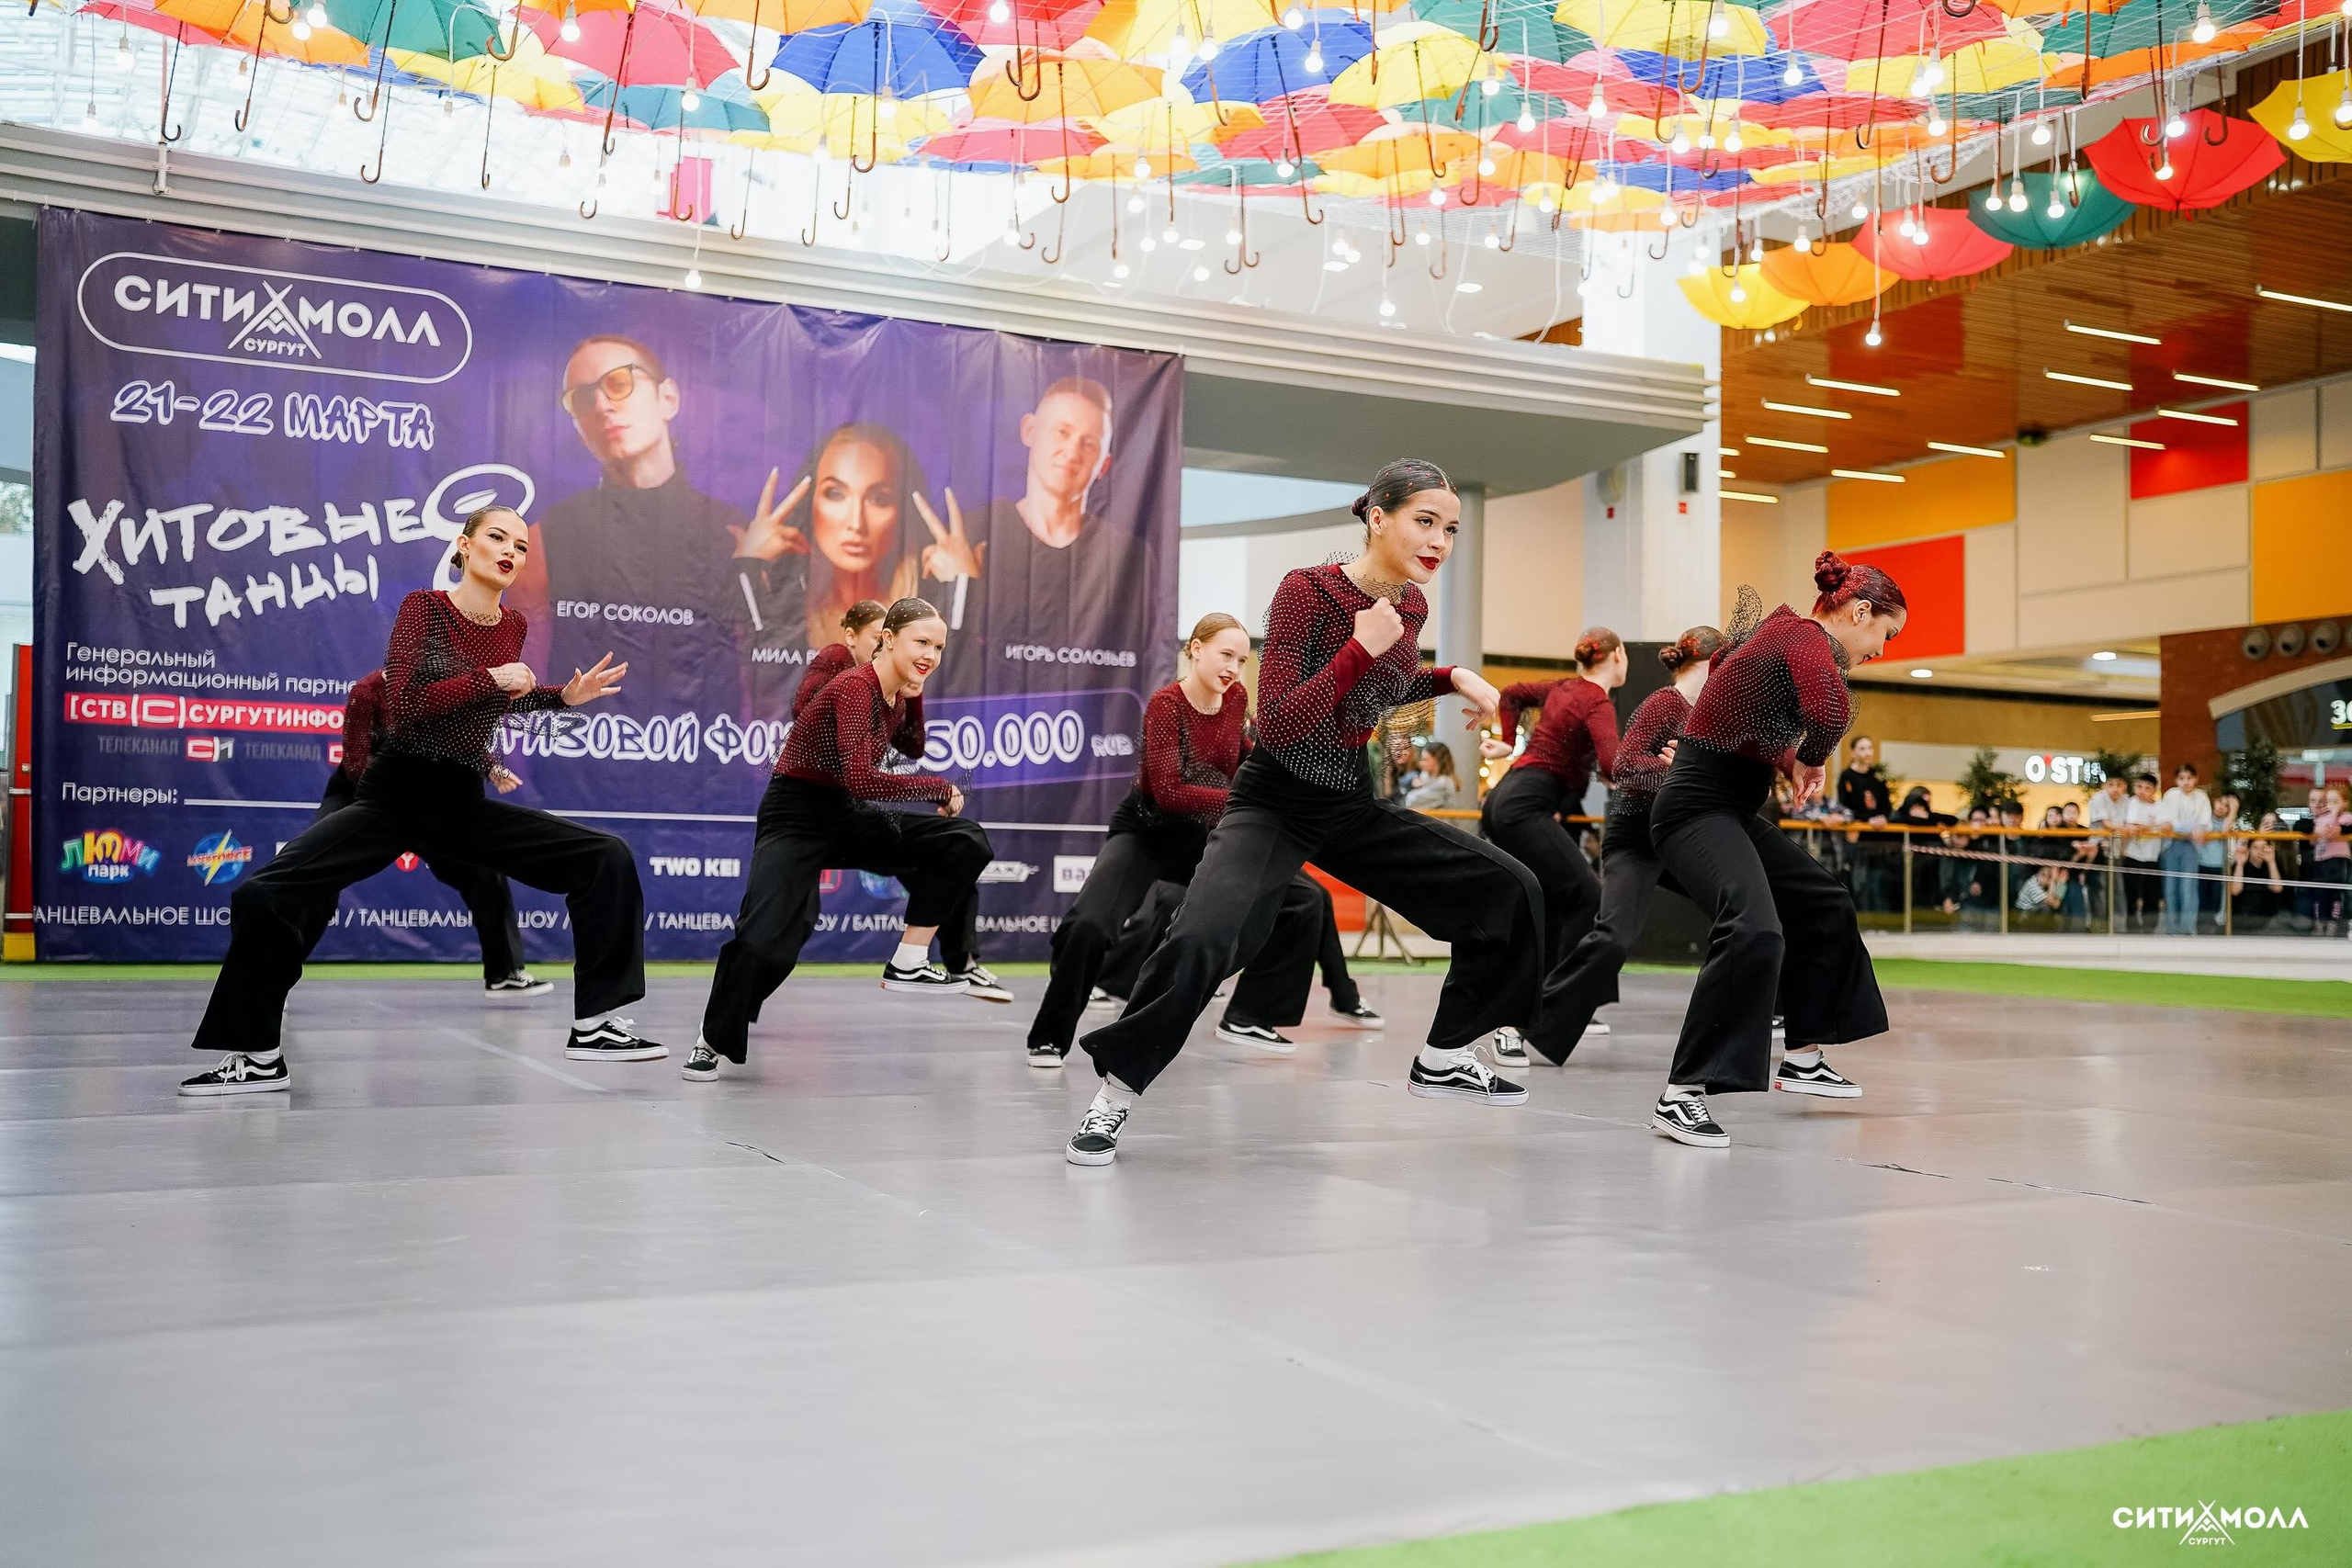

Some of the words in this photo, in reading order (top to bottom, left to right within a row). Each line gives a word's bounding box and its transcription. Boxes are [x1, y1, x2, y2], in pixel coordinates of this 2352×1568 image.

[114, 276, 258, 322] СИТИ
[299, 299, 441, 347] МОЛЛ
[243, 339, 306, 357] СУРГУТ
[110, 379, 275, 435] 21-22
[283, 392, 435, 451] МАРТА
[150, 552, 379, 629] ТАНЦЫ
[557, 600, 600, 619] ЕГОР
[604, 603, 695, 626] СОКОЛОВ
[66, 641, 216, 669] Генеральный
[751, 648, 803, 665] МИЛА
[1005, 644, 1057, 662] ИГОРЬ
[1057, 647, 1137, 668] СОЛОВЬЕВ
[65, 664, 279, 692] информационный
[286, 676, 357, 697] партне
[188, 703, 345, 729] СУРГУТИНФО
[96, 736, 178, 757] ТЕЛЕКАНАЛ
[244, 741, 321, 761] ТЕЛЕКАНАЛ
[496, 710, 700, 763] РИЗОВОЙ
[919, 709, 1085, 773] 50.000
[62, 782, 178, 807] Партнеры:
[88, 864, 129, 880] парк
[650, 857, 702, 876] TWO
[195, 907, 232, 925] ШО
[358, 908, 473, 929] ТАНЦЕВАЛЬ
[657, 912, 735, 931] ТАНЦЕВА
[975, 915, 1049, 933] ВАЛЬНОЕ
